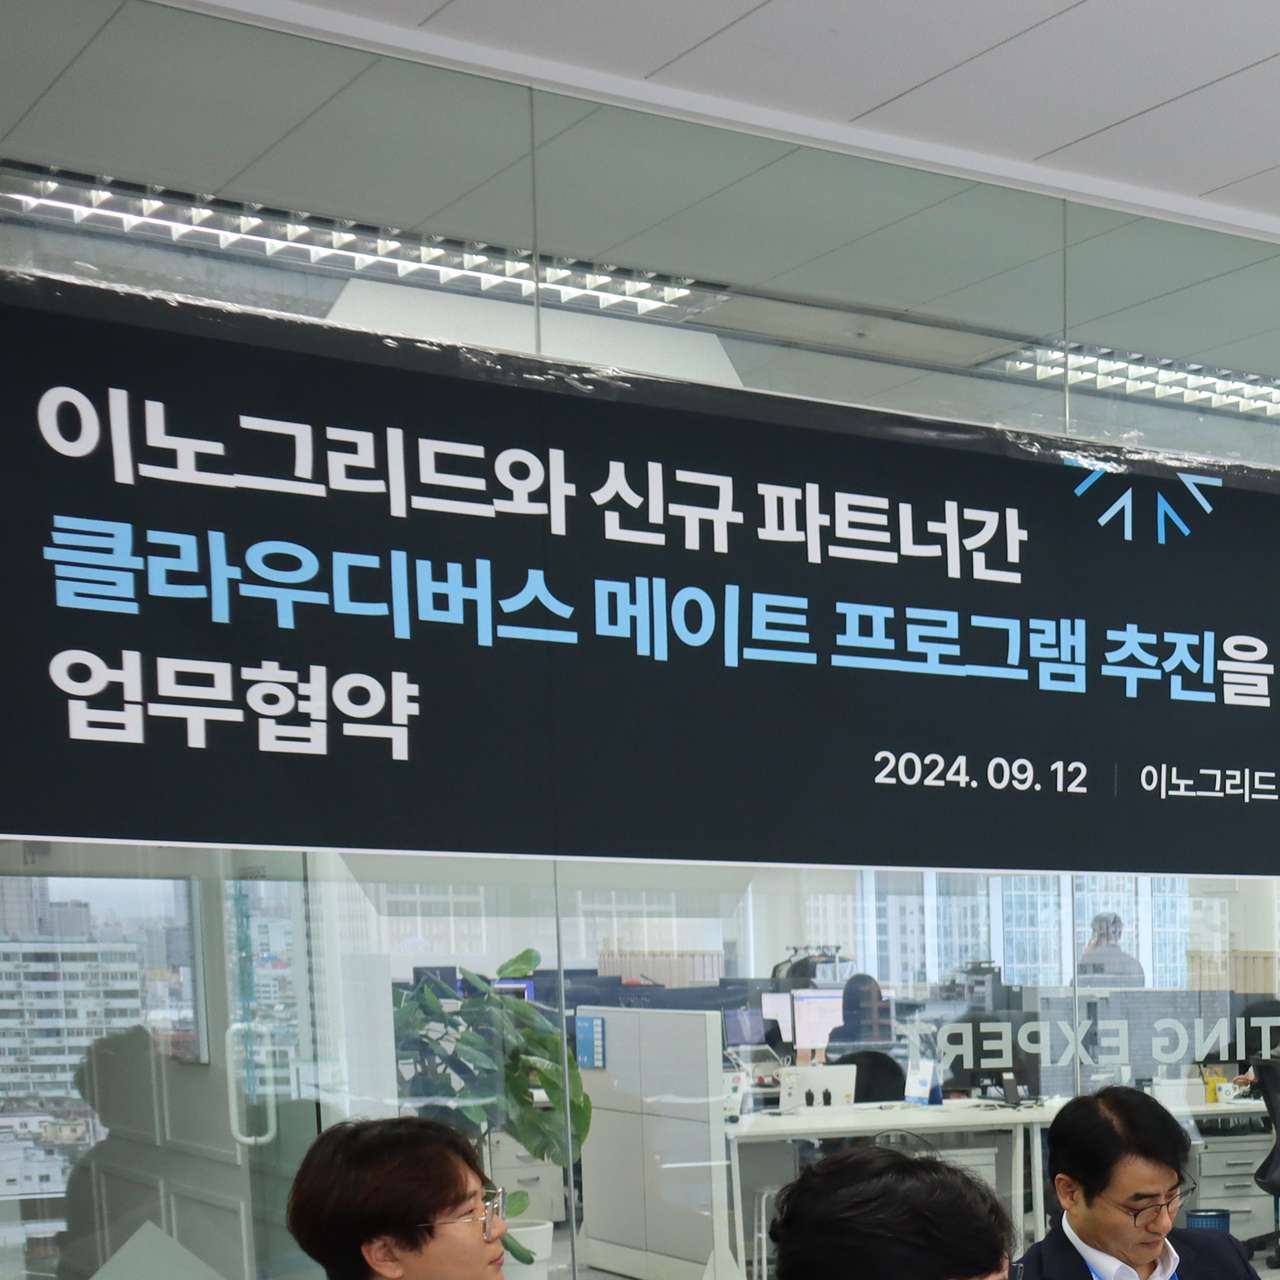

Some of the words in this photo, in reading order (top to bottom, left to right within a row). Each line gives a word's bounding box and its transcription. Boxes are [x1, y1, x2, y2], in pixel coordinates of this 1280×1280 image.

[36, 385, 576, 536] 이노그리드와
[590, 459, 745, 554] 신규
[756, 481, 1028, 585] 파트너간
[42, 514, 579, 647] 클라우디버스
[595, 575, 818, 668] 메이트
[831, 600, 1088, 694] 프로그램
[1101, 622, 1275, 708] 추진을
[48, 647, 421, 761] 업무협약
[873, 750, 977, 790] 2024.
[987, 756, 1042, 793] 09.
[1050, 760, 1088, 794] 12
[1140, 762, 1279, 803] 이노그리드
